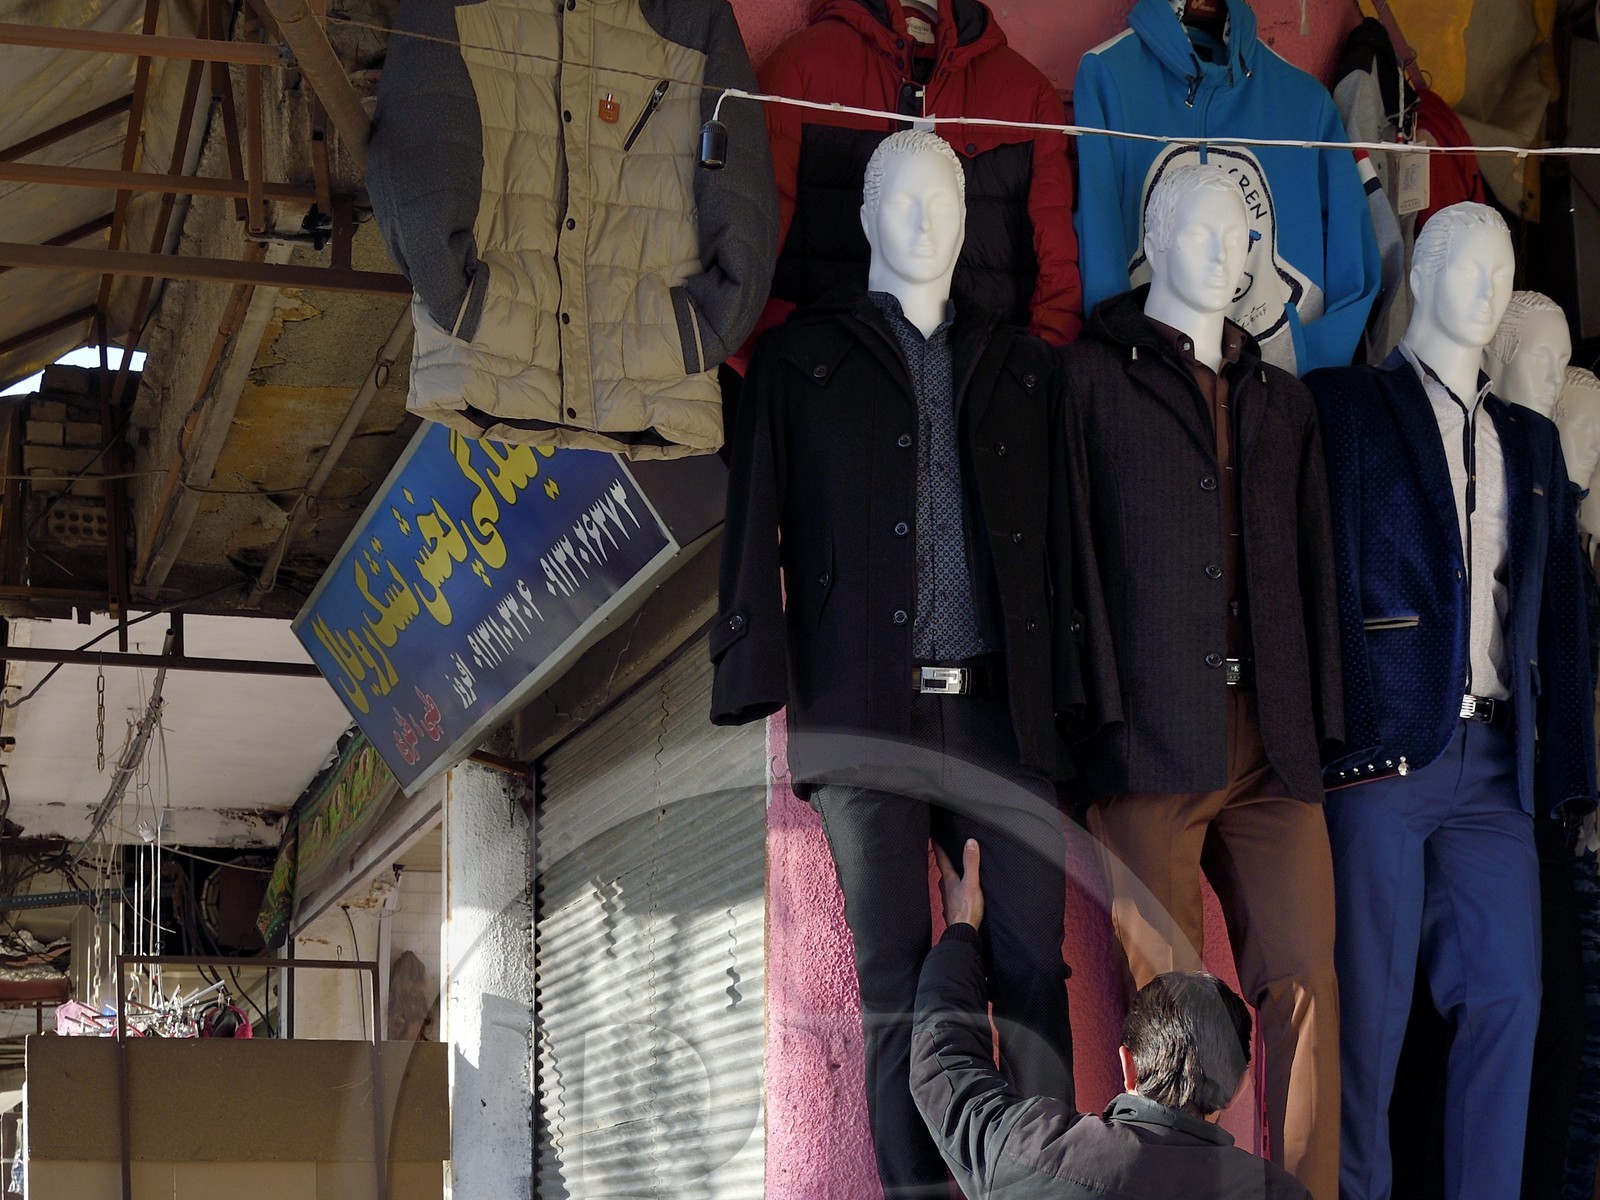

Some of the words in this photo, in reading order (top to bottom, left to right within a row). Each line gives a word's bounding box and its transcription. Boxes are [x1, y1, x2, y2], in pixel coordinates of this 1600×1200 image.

[354, 536, 420, 648] تشک
[391, 487, 492, 626] پخش
[540, 478, 641, 597] ۰۹۱۳۲۰۲۶۳۷۳
[310, 611, 399, 714] رویال
[467, 579, 545, 670] ۰۹۱۳۱۱۰۳۳۰۴
